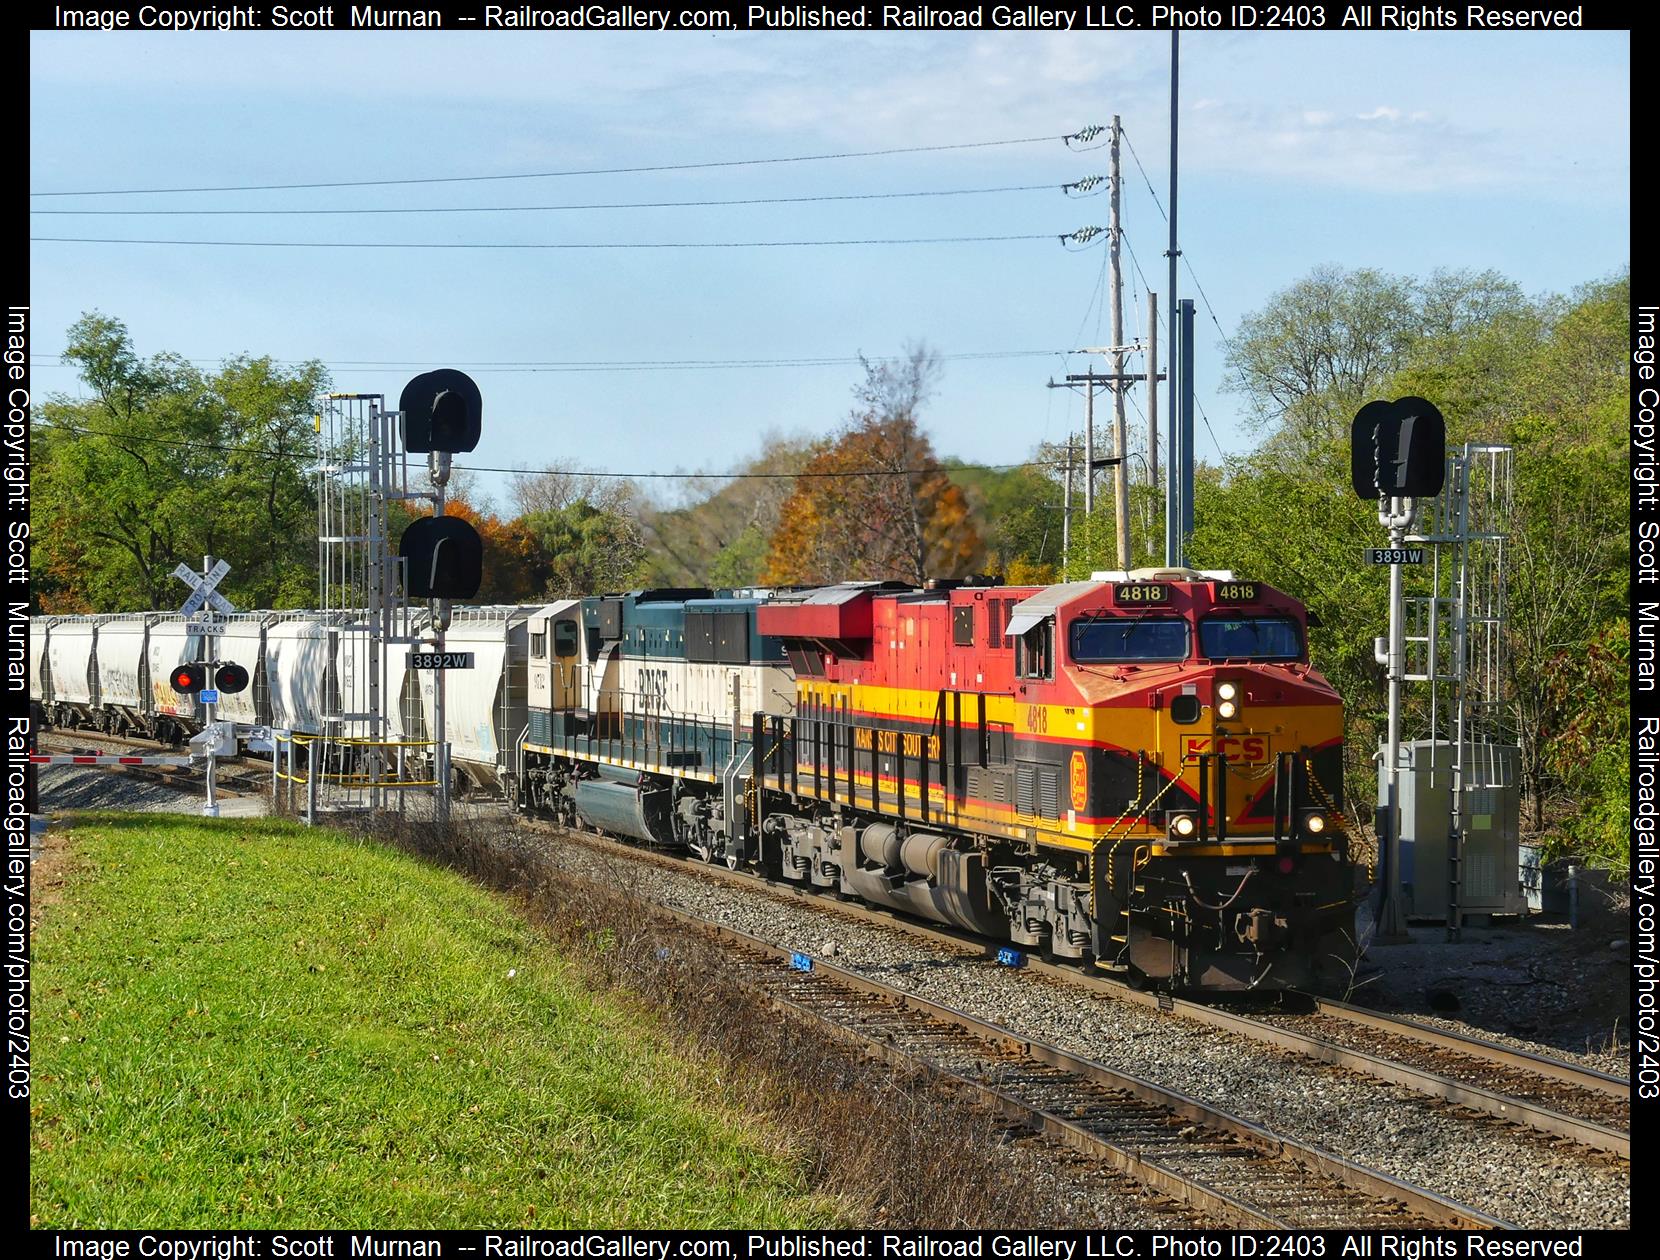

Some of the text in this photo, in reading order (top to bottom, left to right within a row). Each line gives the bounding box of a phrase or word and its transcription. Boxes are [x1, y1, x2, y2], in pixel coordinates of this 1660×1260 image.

[1375, 551, 1421, 563] 3891W
[177, 565, 232, 615] RAIL ROAD
[1120, 585, 1161, 600] 4818
[1220, 585, 1254, 599] 4818
[203, 613, 209, 622] 2
[188, 625, 224, 633] TRACKS
[414, 654, 466, 667] 3892W
[637, 668, 668, 711] BNSF
[1027, 704, 1047, 733] 4818
[856, 728, 883, 751] KANSS
[904, 734, 941, 760] SOUTERN
[1188, 737, 1264, 761] KCS
